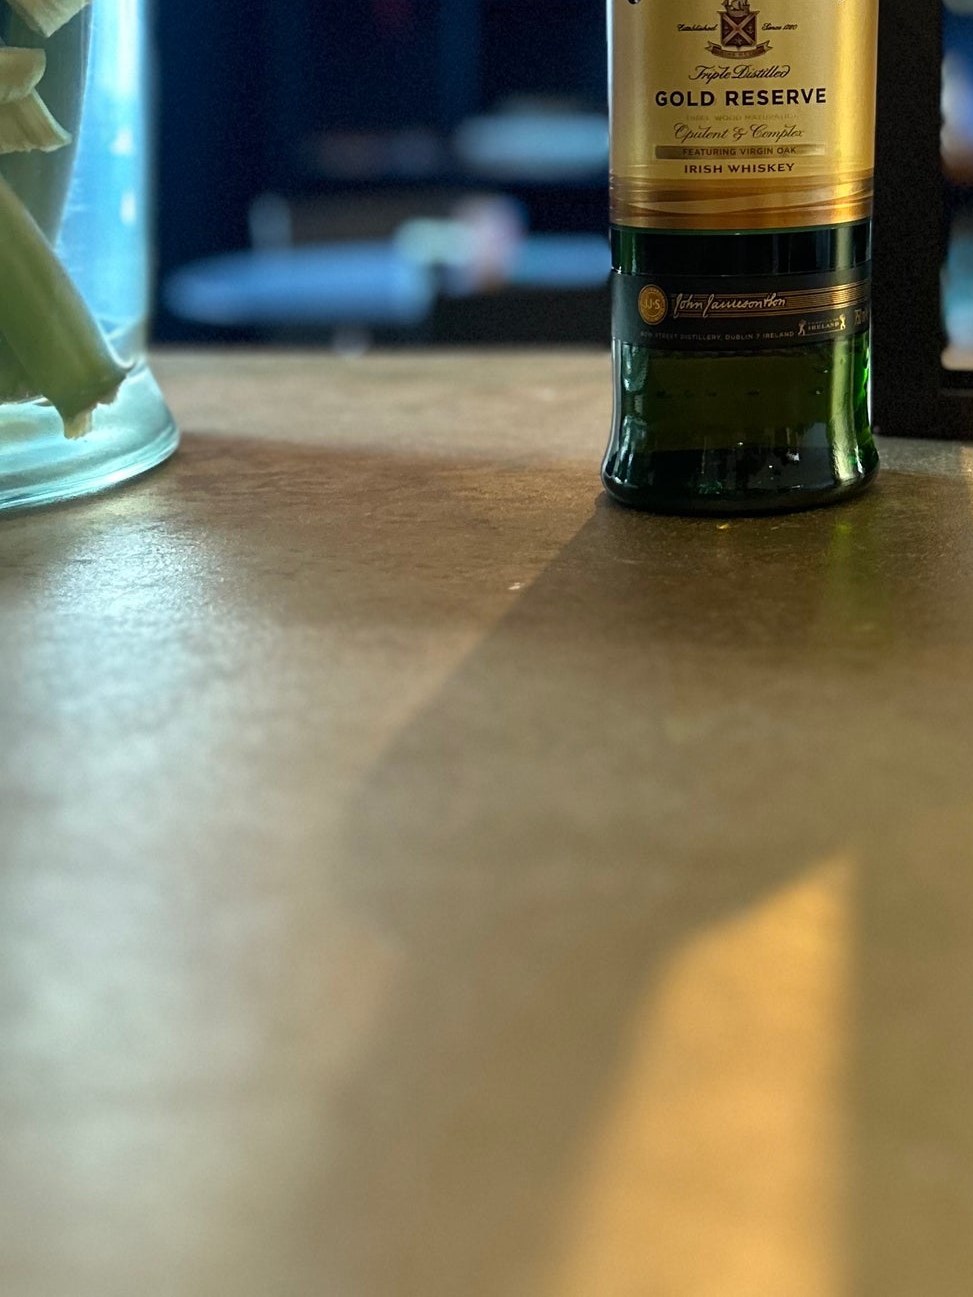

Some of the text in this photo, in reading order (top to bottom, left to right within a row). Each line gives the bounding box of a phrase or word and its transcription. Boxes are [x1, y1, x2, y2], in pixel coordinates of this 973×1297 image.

[688, 64, 791, 85] Triple Distilled
[655, 88, 827, 107] GOLD RESERVE
[673, 122, 805, 143] Opulent & Complex
[683, 146, 797, 156] FEATURING VIRGIN OAK
[684, 162, 795, 174] IRISH WHISKEY
[674, 293, 703, 319] John
[702, 293, 763, 319] Jameson
[725, 333, 754, 341] DUBLIN
[762, 330, 795, 340] IRELAND
